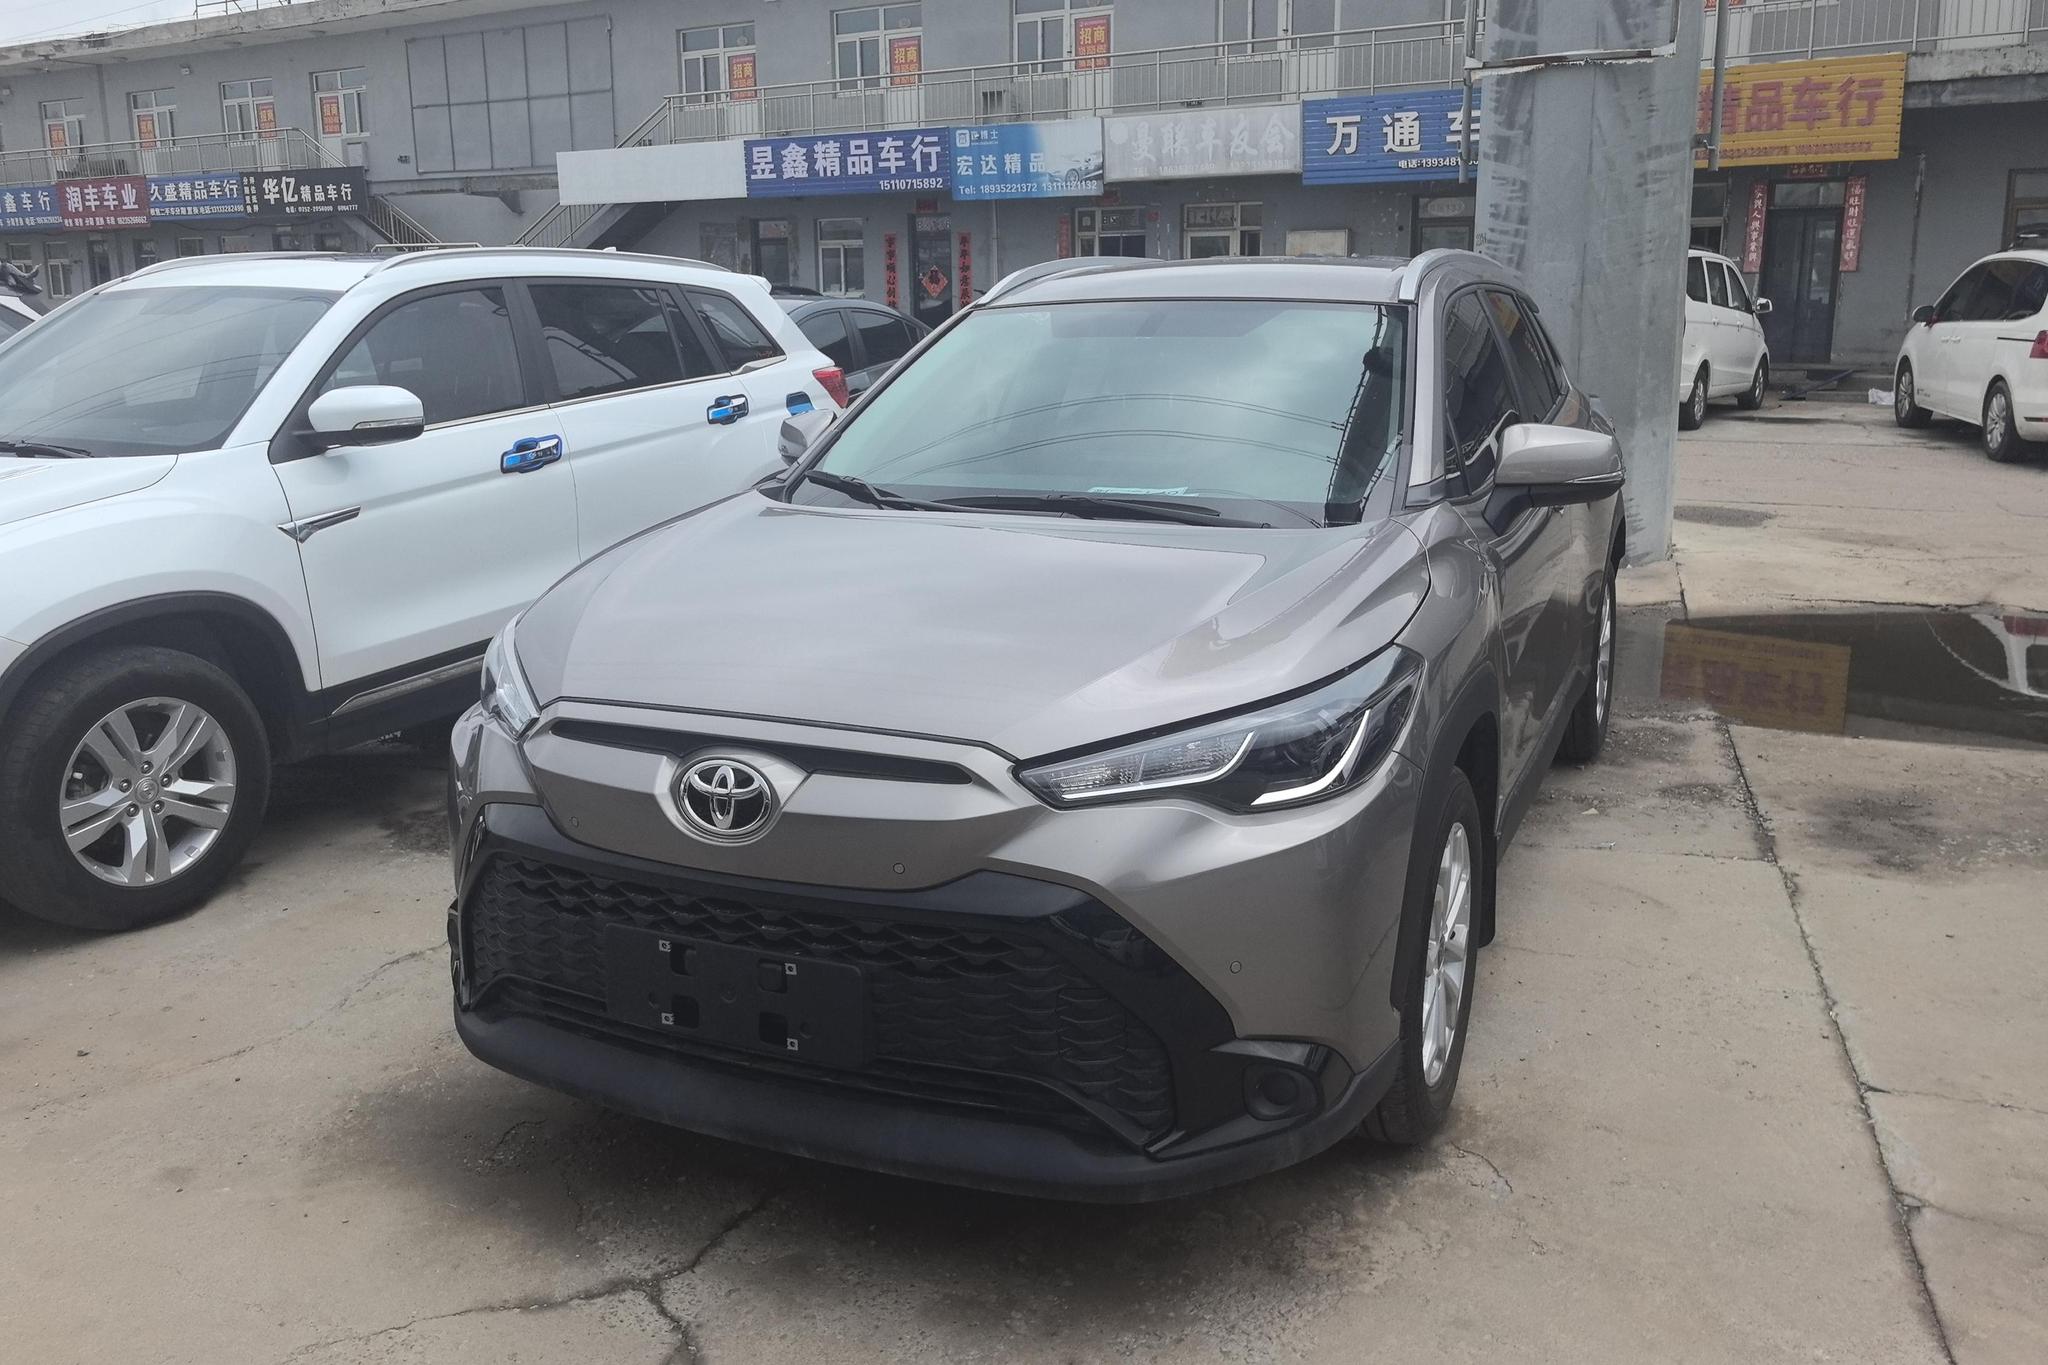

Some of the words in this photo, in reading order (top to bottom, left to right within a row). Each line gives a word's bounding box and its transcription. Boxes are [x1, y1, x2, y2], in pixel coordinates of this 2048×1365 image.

[1079, 26, 1106, 45] 招商
[894, 47, 918, 64] 招商
[733, 62, 753, 79] 招商
[1326, 106, 1481, 155] 万通车
[750, 134, 941, 180] 昱鑫精品车行
[956, 152, 1046, 176] 宏达精品
[150, 179, 238, 201] 久盛精品车行
[879, 178, 944, 190] 15110715892
[958, 185, 976, 195] Tel:
[980, 184, 1038, 193] 18935221372
[0, 190, 51, 213] 鑫车行
[65, 183, 139, 213] 润丰车业
